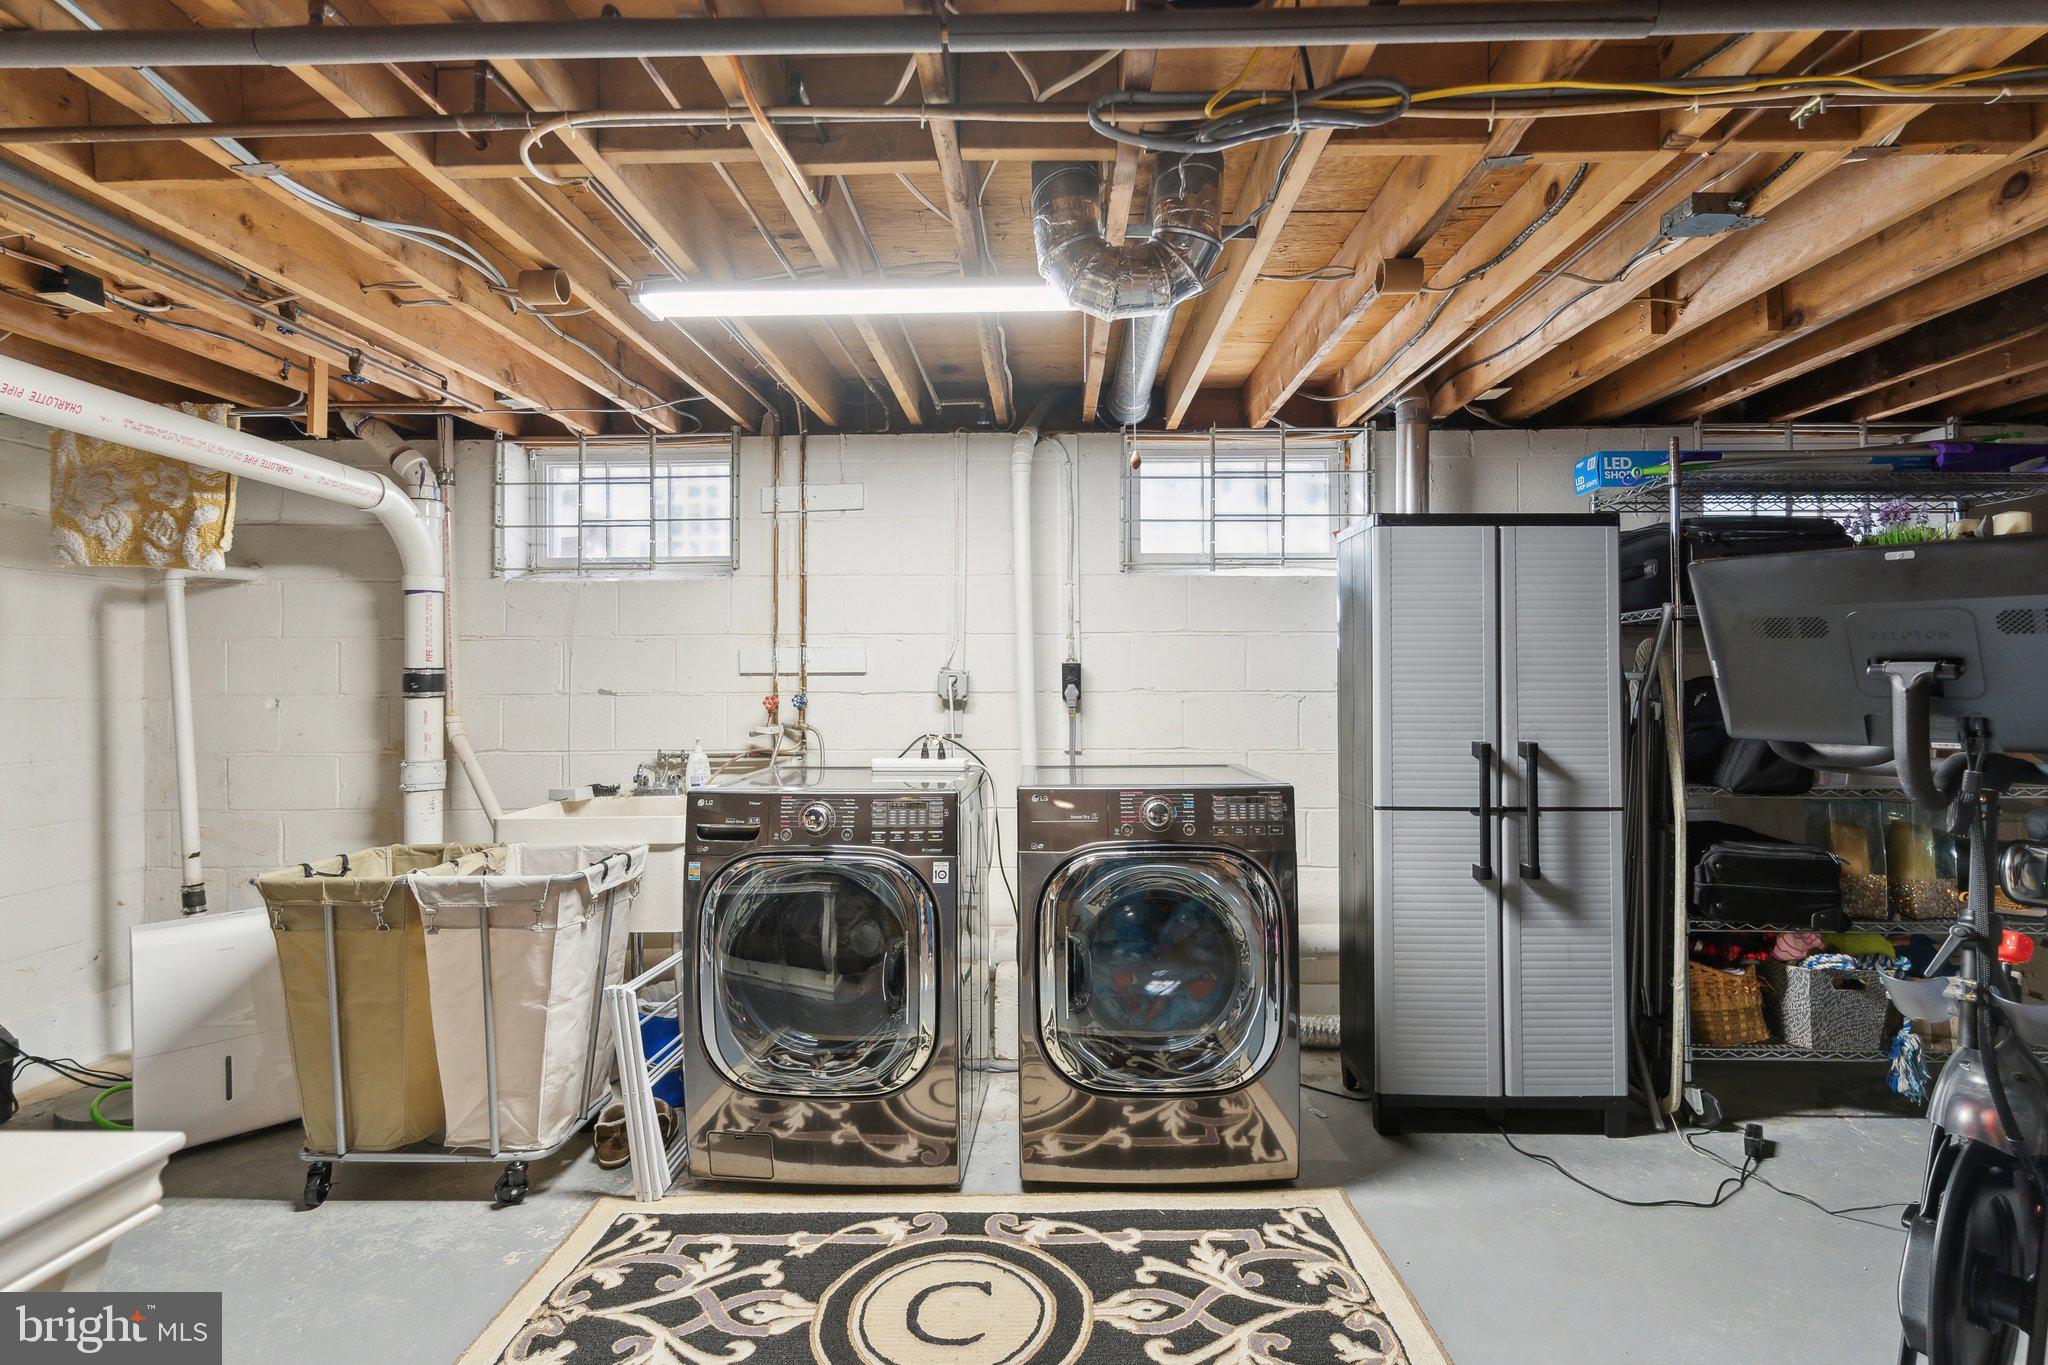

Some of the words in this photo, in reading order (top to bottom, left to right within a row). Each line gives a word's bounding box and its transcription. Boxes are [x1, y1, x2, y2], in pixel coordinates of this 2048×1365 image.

[0, 382, 25, 398] PIPE
[28, 390, 84, 415] CHARLOTTE
[243, 454, 260, 466] PIPE
[259, 459, 294, 476] CHARLOTTE
[1603, 457, 1632, 470] LED
[1574, 475, 1585, 487] LED
[906, 1280, 993, 1347] C
